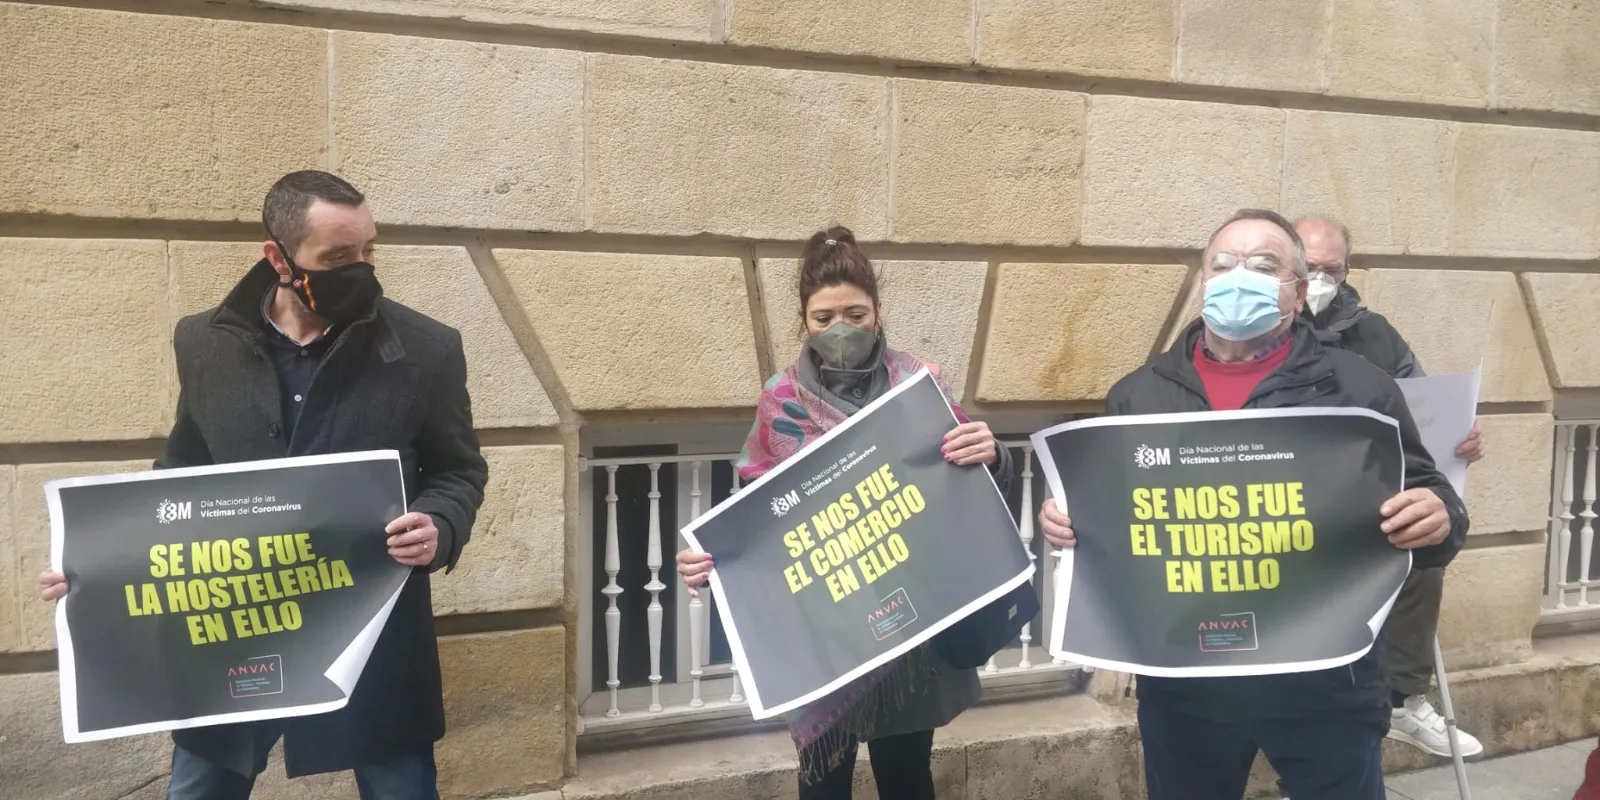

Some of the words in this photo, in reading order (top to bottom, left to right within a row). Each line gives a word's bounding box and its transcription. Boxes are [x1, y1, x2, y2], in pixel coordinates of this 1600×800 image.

[1138, 446, 1171, 467] 8M
[1179, 447, 1194, 455] Día
[1196, 444, 1235, 453] Nacional
[1237, 443, 1249, 451] de
[1179, 456, 1220, 465] Víctimas
[1222, 455, 1236, 463] del
[1238, 451, 1295, 462] Coronavirus
[800, 480, 812, 490] Día
[812, 462, 838, 482] Nacional
[838, 456, 848, 465] de
[846, 450, 857, 459] las
[804, 477, 832, 496] Víctimas
[832, 470, 842, 479] del
[842, 445, 877, 472] Coronavirus
[160, 500, 192, 522] 8M
[200, 500, 213, 508] Día
[216, 496, 250, 506] Nacional
[252, 496, 262, 504] de
[264, 495, 276, 503] las
[200, 508, 236, 518] Víctimas
[237, 507, 250, 515] del
[252, 503, 302, 514] Coronavirus
[774, 489, 801, 514] 8M
[784, 522, 816, 558] SE
[811, 492, 860, 541] NOS
[855, 463, 900, 510] FUE
[1132, 487, 1170, 520] SE
[1174, 485, 1241, 519] NOS
[1247, 482, 1306, 517] FUE
[149, 543, 185, 578] SE
[191, 537, 253, 575] NOS
[258, 532, 316, 568] FUE
[783, 560, 813, 595] EL
[810, 484, 926, 576] COMERCIO
[1130, 524, 1162, 556] EL
[1165, 519, 1314, 556] TURISMO
[825, 564, 861, 603] EN
[856, 533, 910, 585] ELLO
[1166, 560, 1204, 593] EN
[1210, 558, 1280, 593] ELLO
[125, 583, 163, 617] LA
[166, 557, 354, 613] HOSTELERÍA
[186, 612, 229, 646] EN
[230, 601, 303, 639] ELLO
[868, 596, 904, 623] ANVAC
[1198, 619, 1248, 630] ANVAC
[228, 662, 275, 677] ANVAC
